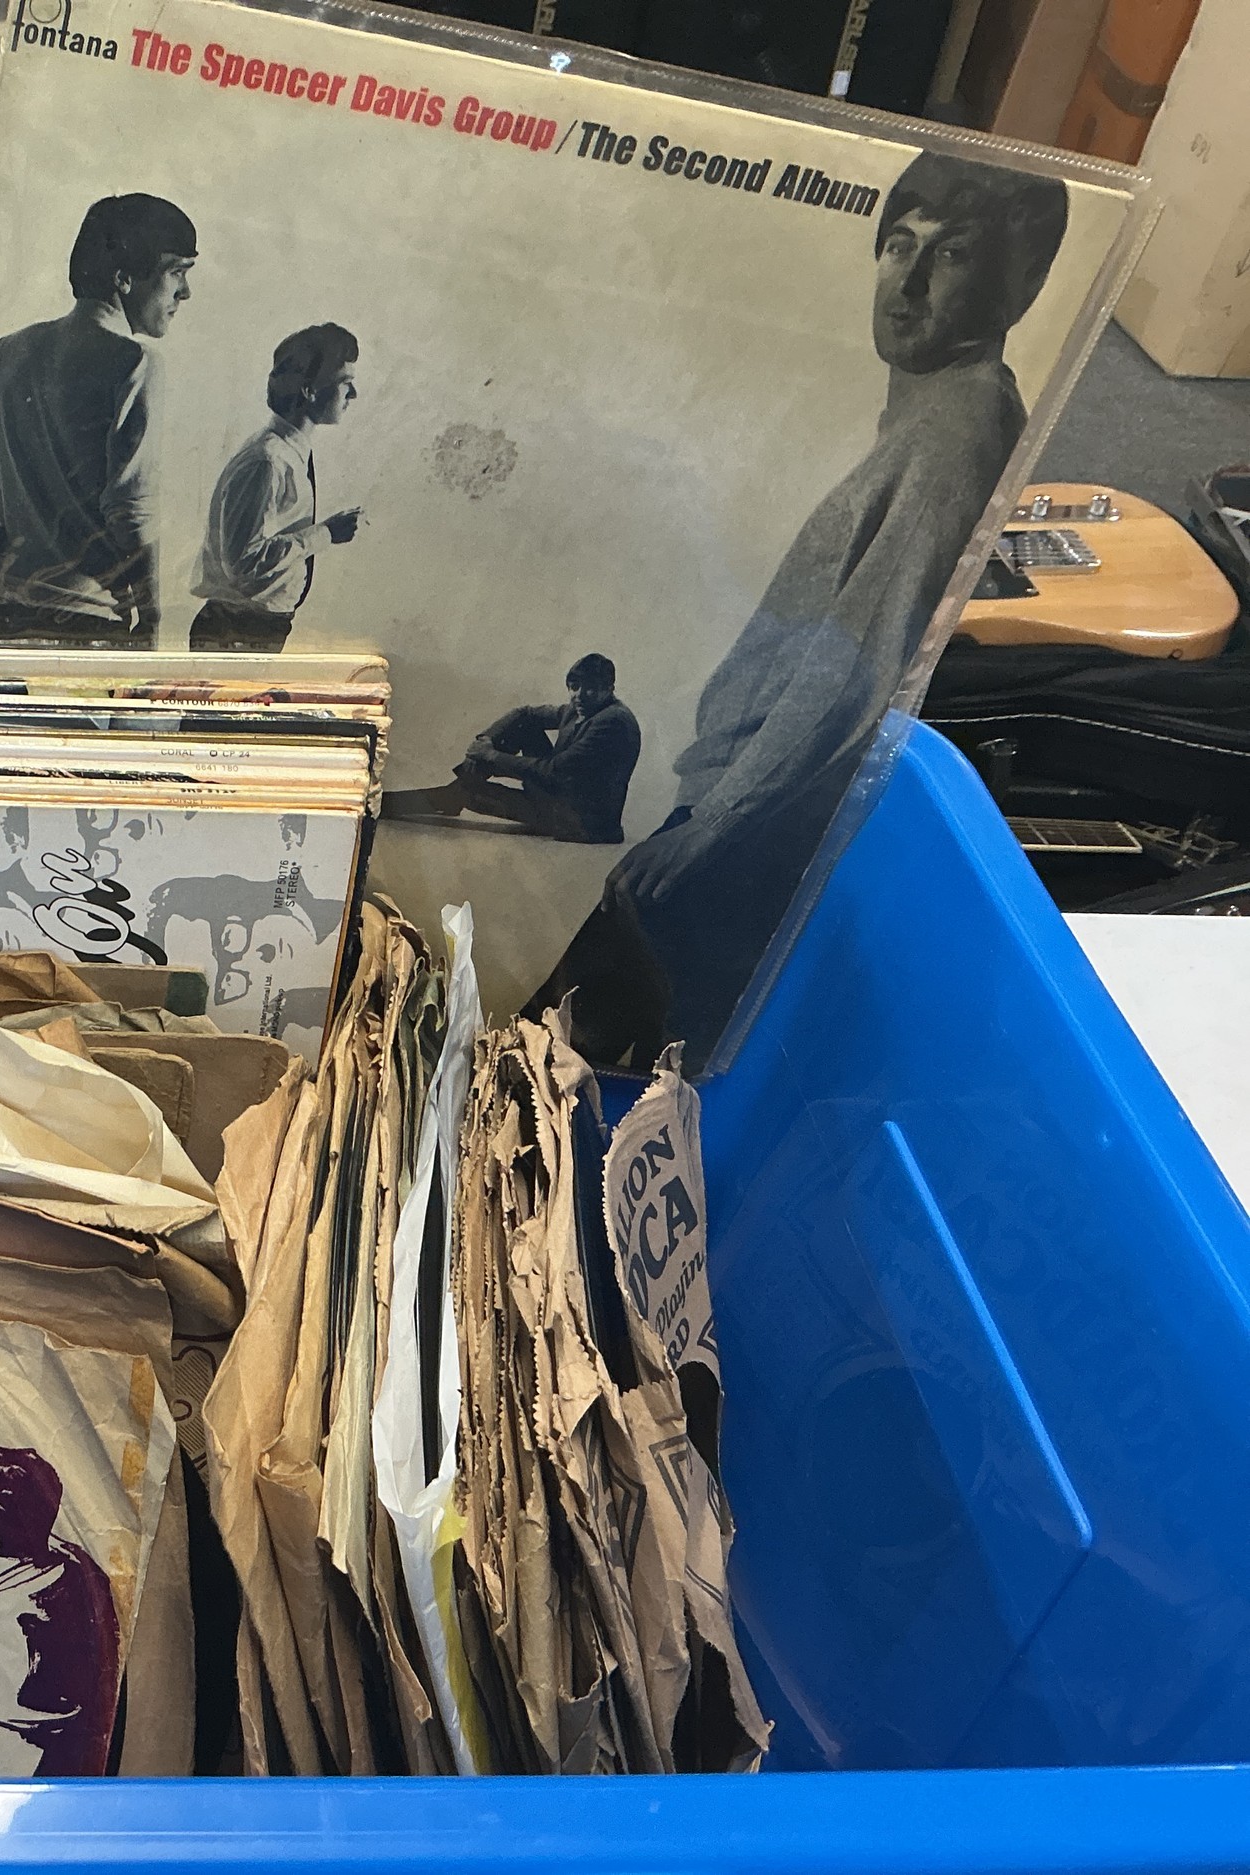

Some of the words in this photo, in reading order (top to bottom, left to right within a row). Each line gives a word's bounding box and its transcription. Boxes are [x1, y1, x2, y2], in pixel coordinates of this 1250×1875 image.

[11, 0, 118, 60] fontana
[131, 28, 192, 75] The
[200, 43, 347, 106] Spencer
[351, 74, 446, 127] Davis
[642, 135, 771, 193] Second
[774, 163, 881, 217] Album
[161, 699, 215, 707] CONTOUR
[160, 748, 195, 757] CORAL
[222, 750, 236, 758] CP
[222, 765, 239, 773] 180
[275, 860, 289, 885] 50176
[273, 887, 284, 909] MFP
